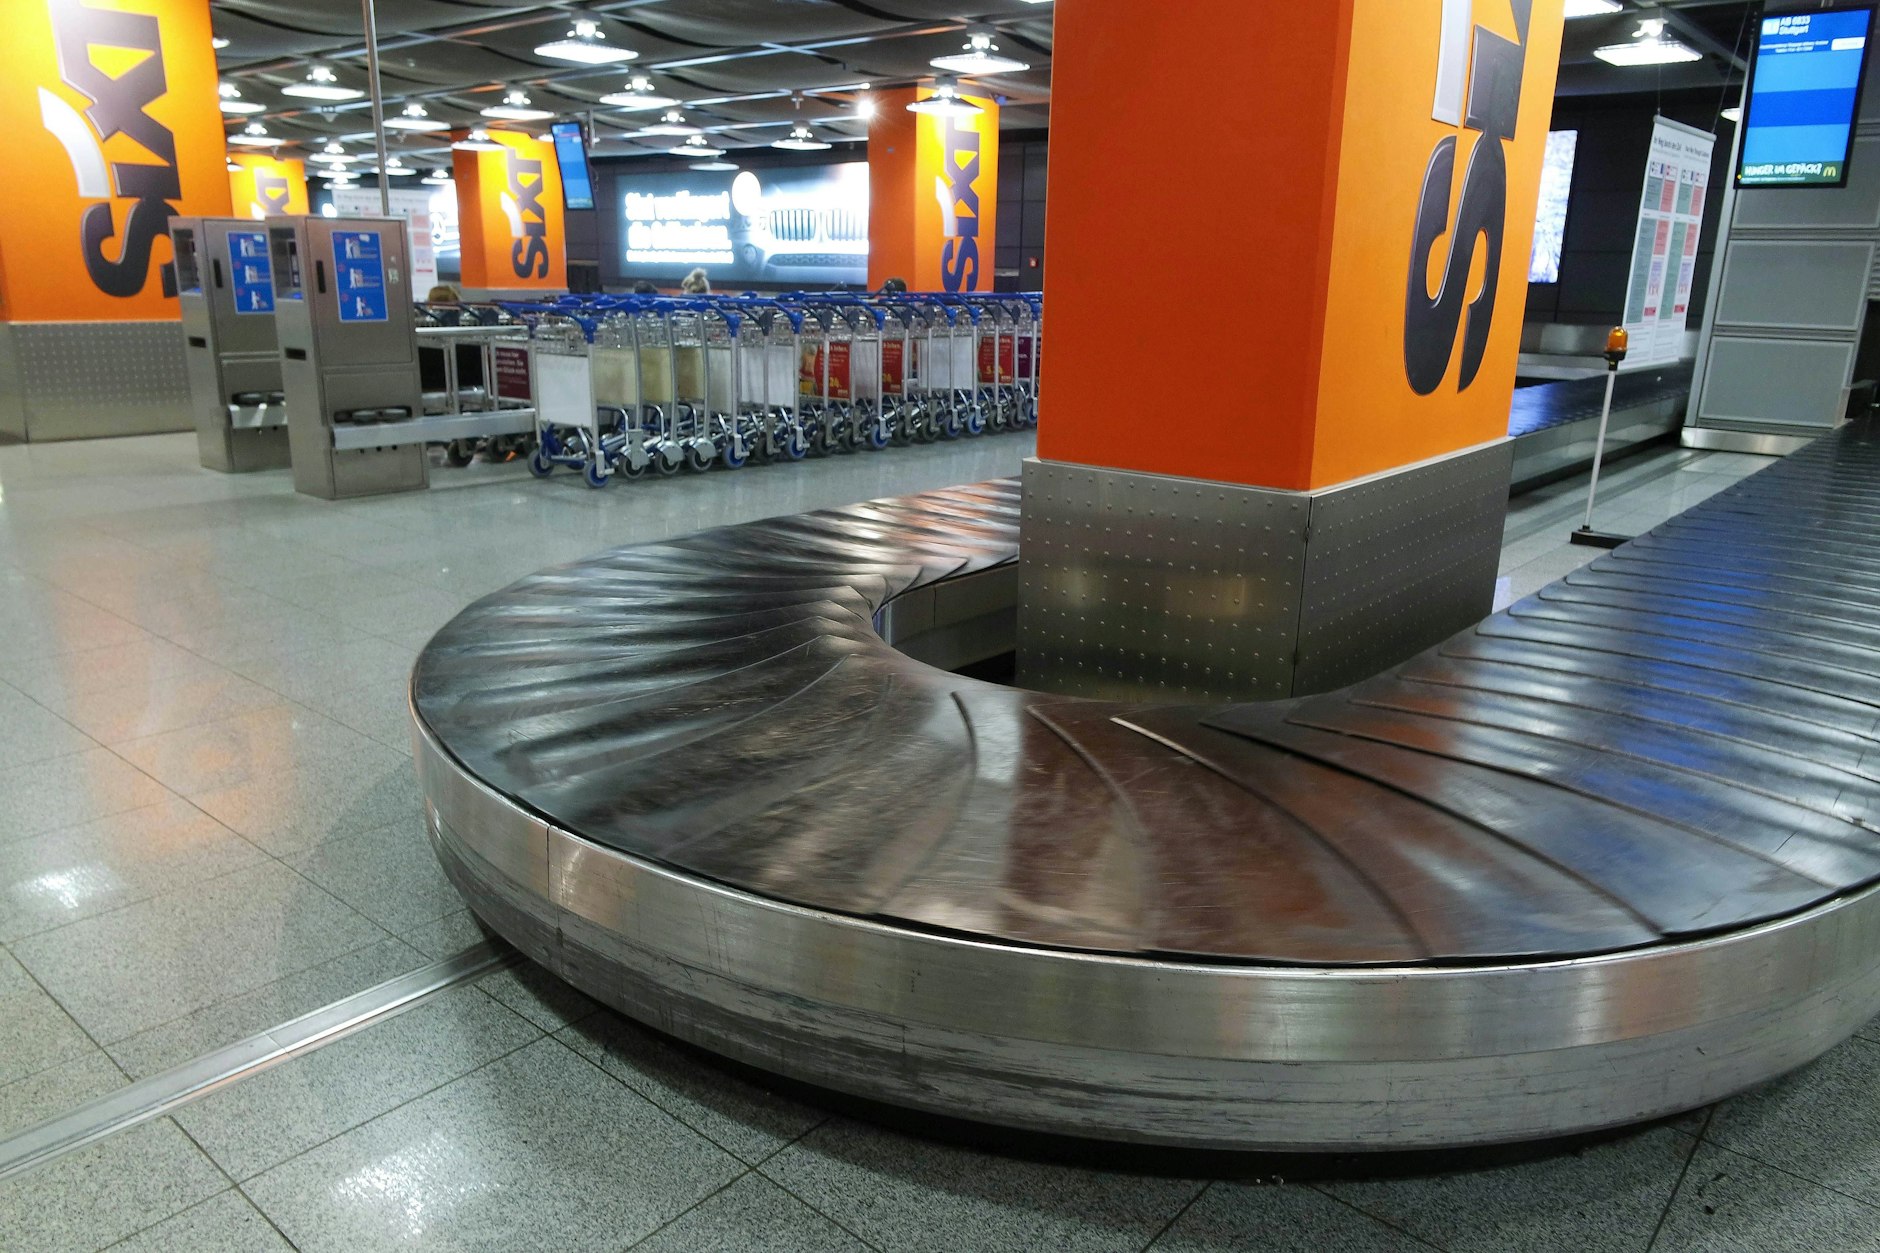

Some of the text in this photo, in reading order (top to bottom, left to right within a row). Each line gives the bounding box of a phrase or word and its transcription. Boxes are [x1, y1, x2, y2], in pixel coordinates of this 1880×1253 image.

[500, 147, 549, 280] SIXT
[935, 116, 980, 293] SIXT
[1404, 0, 1533, 396] SI
